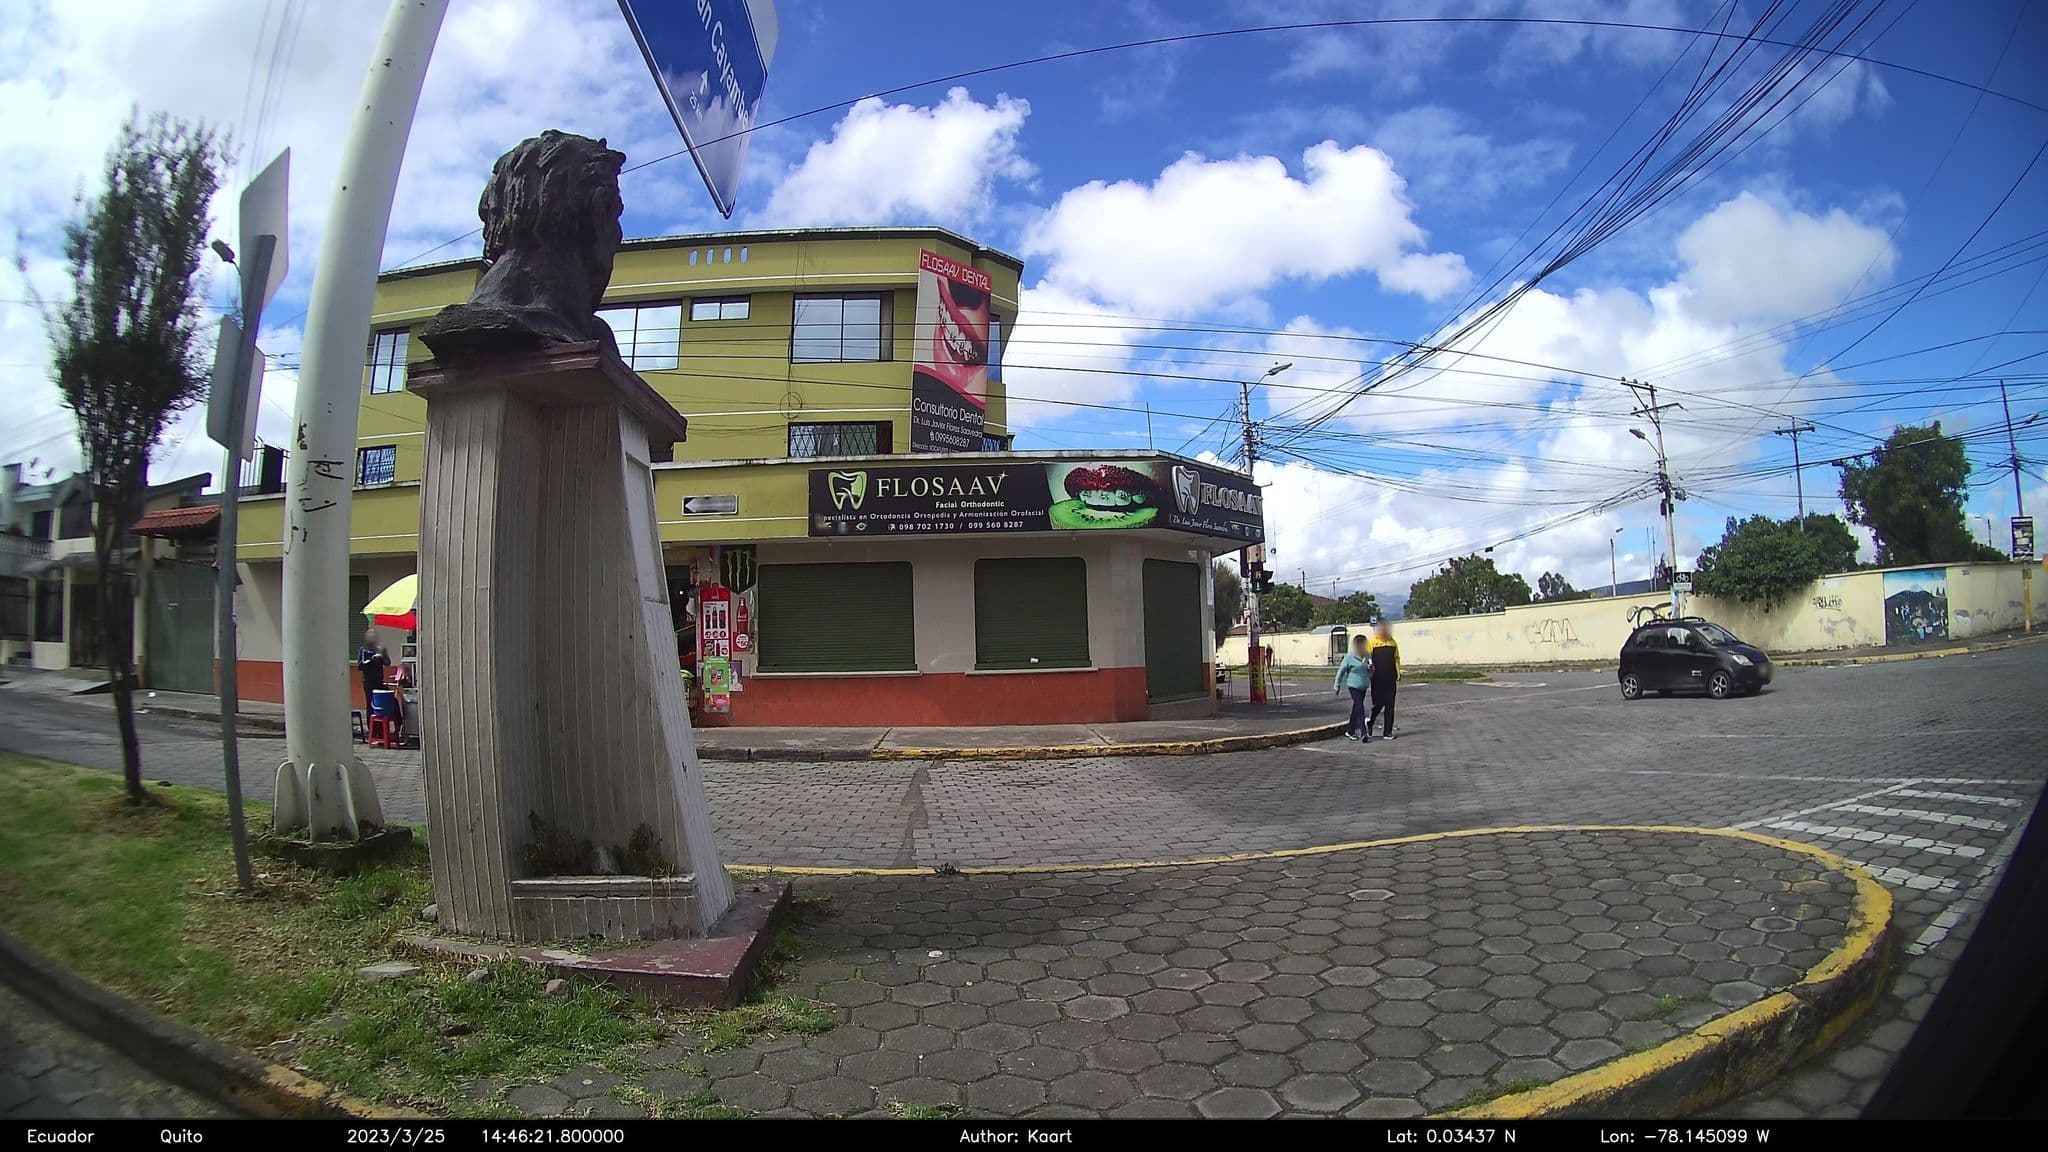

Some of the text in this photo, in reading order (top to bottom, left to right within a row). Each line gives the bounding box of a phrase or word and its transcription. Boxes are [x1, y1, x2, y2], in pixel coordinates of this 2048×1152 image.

[711, 20, 749, 131] Cayambe
[962, 268, 991, 291] DENTAL
[913, 397, 984, 426] Consultorio Dental
[876, 475, 1003, 498] FLOSAAV
[935, 500, 1005, 509] Facial Orthodontic
[1200, 481, 1263, 516] FLOSAAV
[859, 512, 868, 520] en
[870, 512, 911, 520] Ortodoncia
[899, 523, 914, 531] 098
[916, 522, 931, 530] 702
[935, 522, 955, 530] 1730
[968, 521, 983, 529] 099
